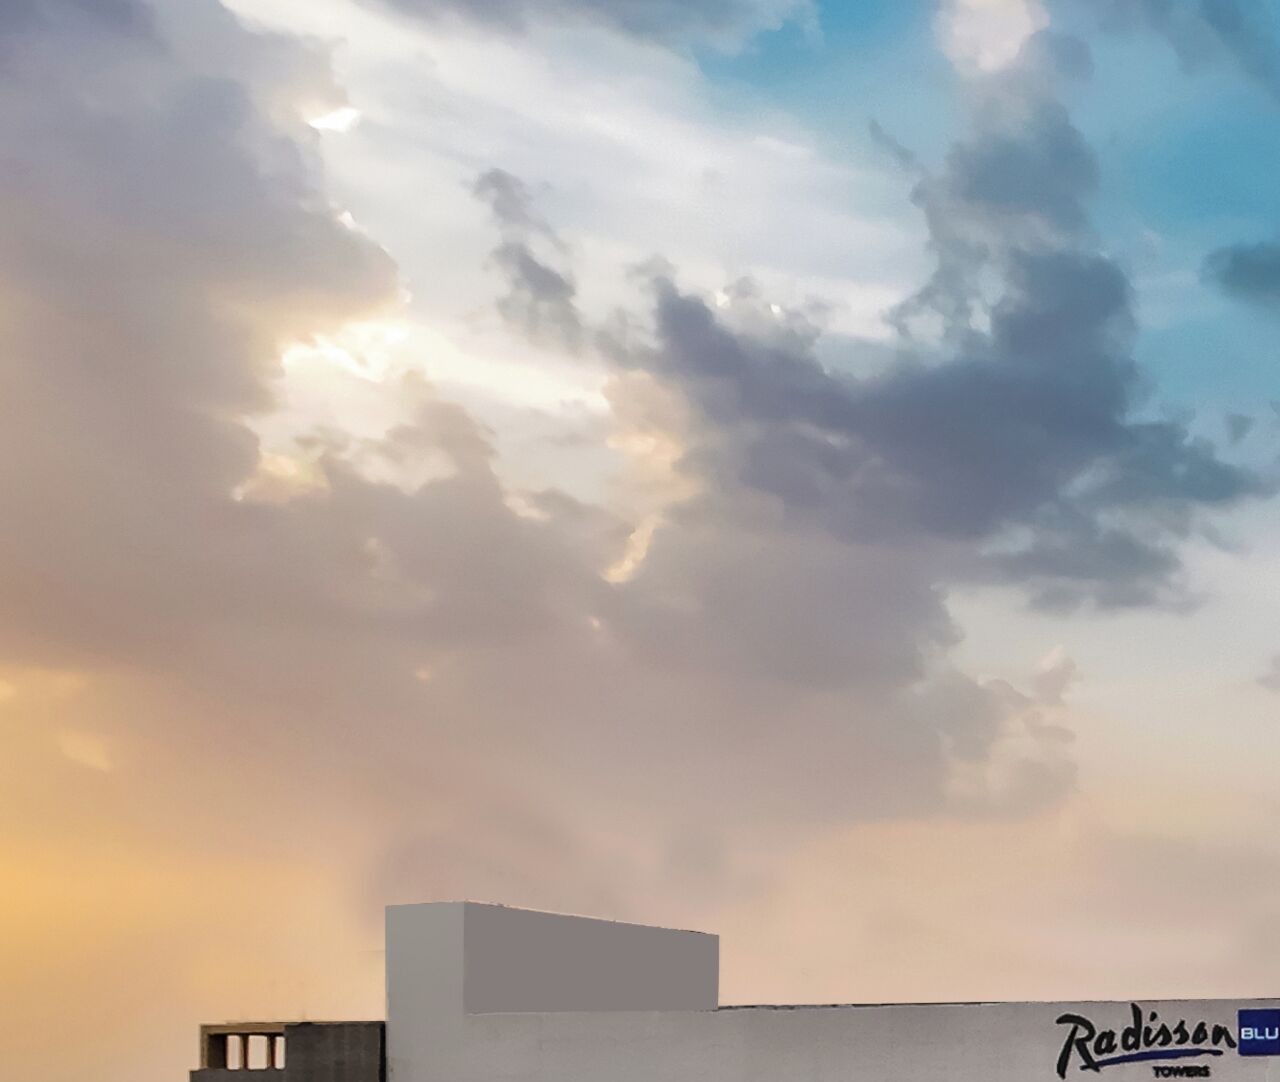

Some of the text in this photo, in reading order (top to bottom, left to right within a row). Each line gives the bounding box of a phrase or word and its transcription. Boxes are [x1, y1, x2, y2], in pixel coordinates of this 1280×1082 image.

[1056, 1002, 1279, 1080] Radisson BLU
[1152, 1065, 1210, 1078] TOWERS
